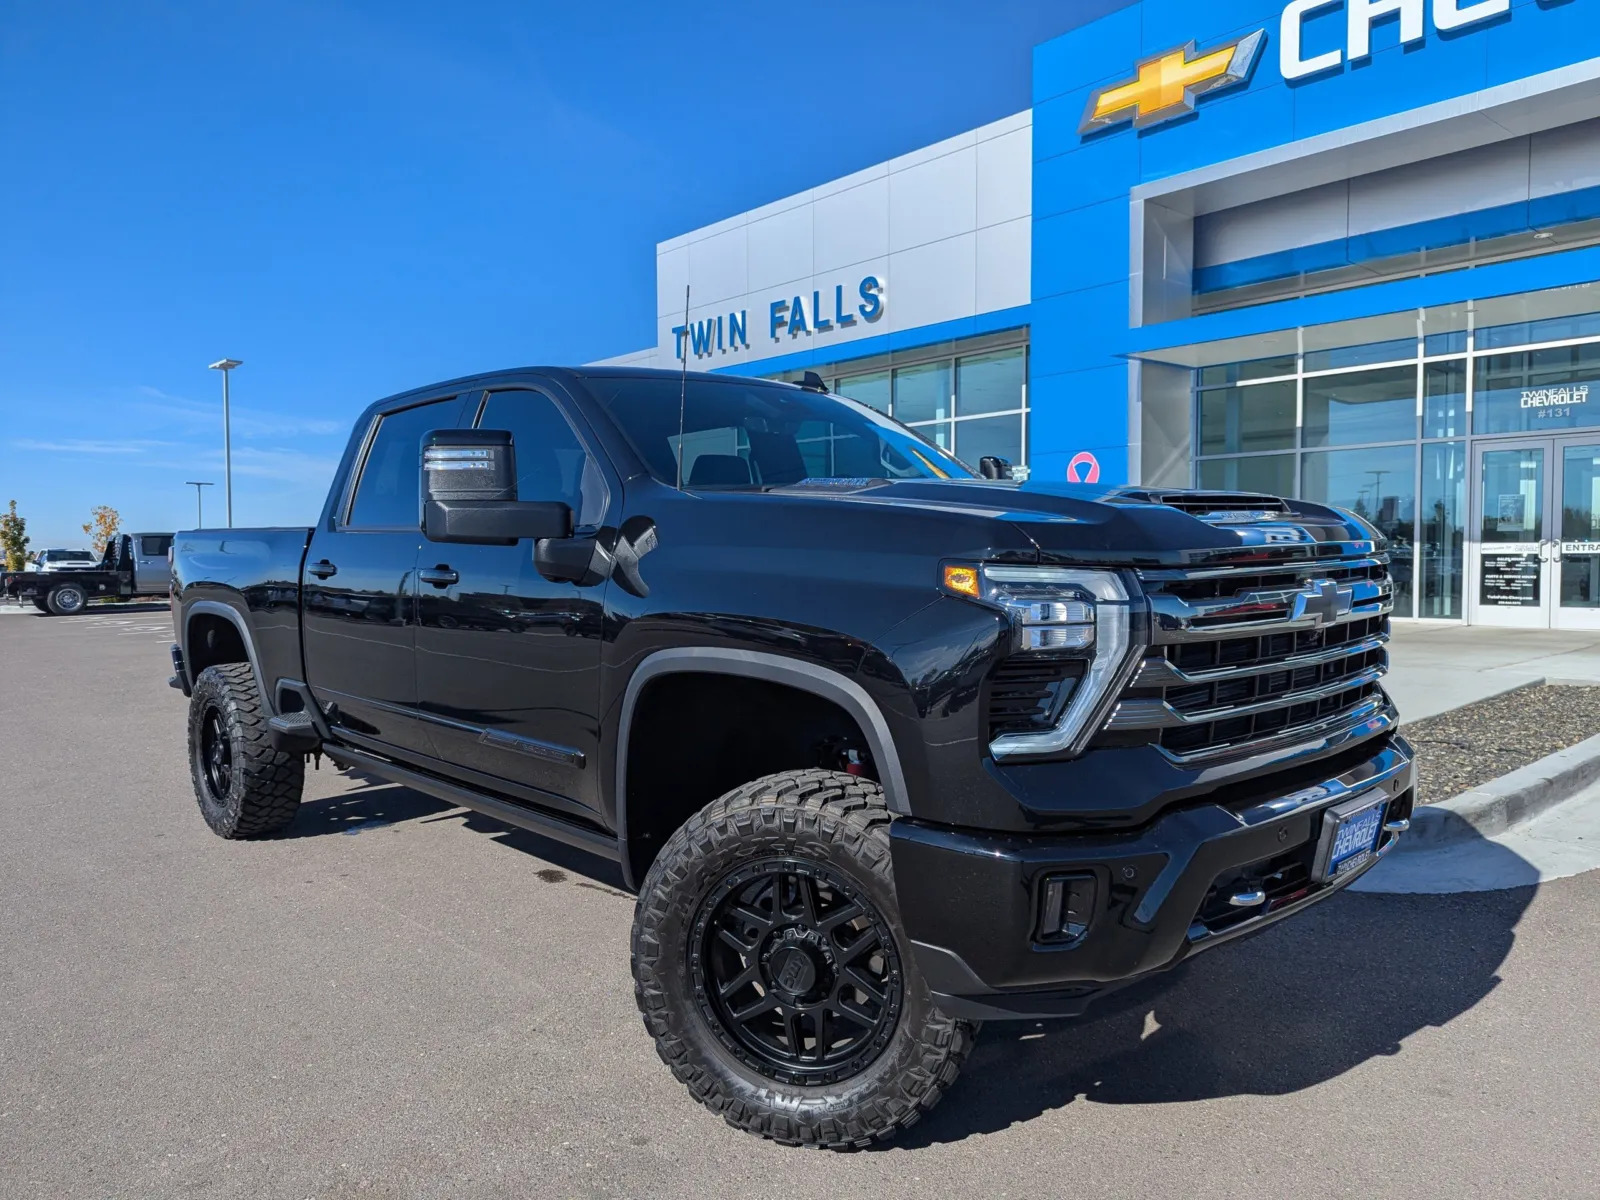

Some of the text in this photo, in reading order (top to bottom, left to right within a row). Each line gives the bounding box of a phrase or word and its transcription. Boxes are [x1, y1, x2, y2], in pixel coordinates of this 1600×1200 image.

[672, 276, 882, 360] TWIN FALLS
[1520, 392, 1588, 408] CHEVROLET
[1537, 407, 1571, 418] #131
[1332, 822, 1379, 860] CHEVROLET
